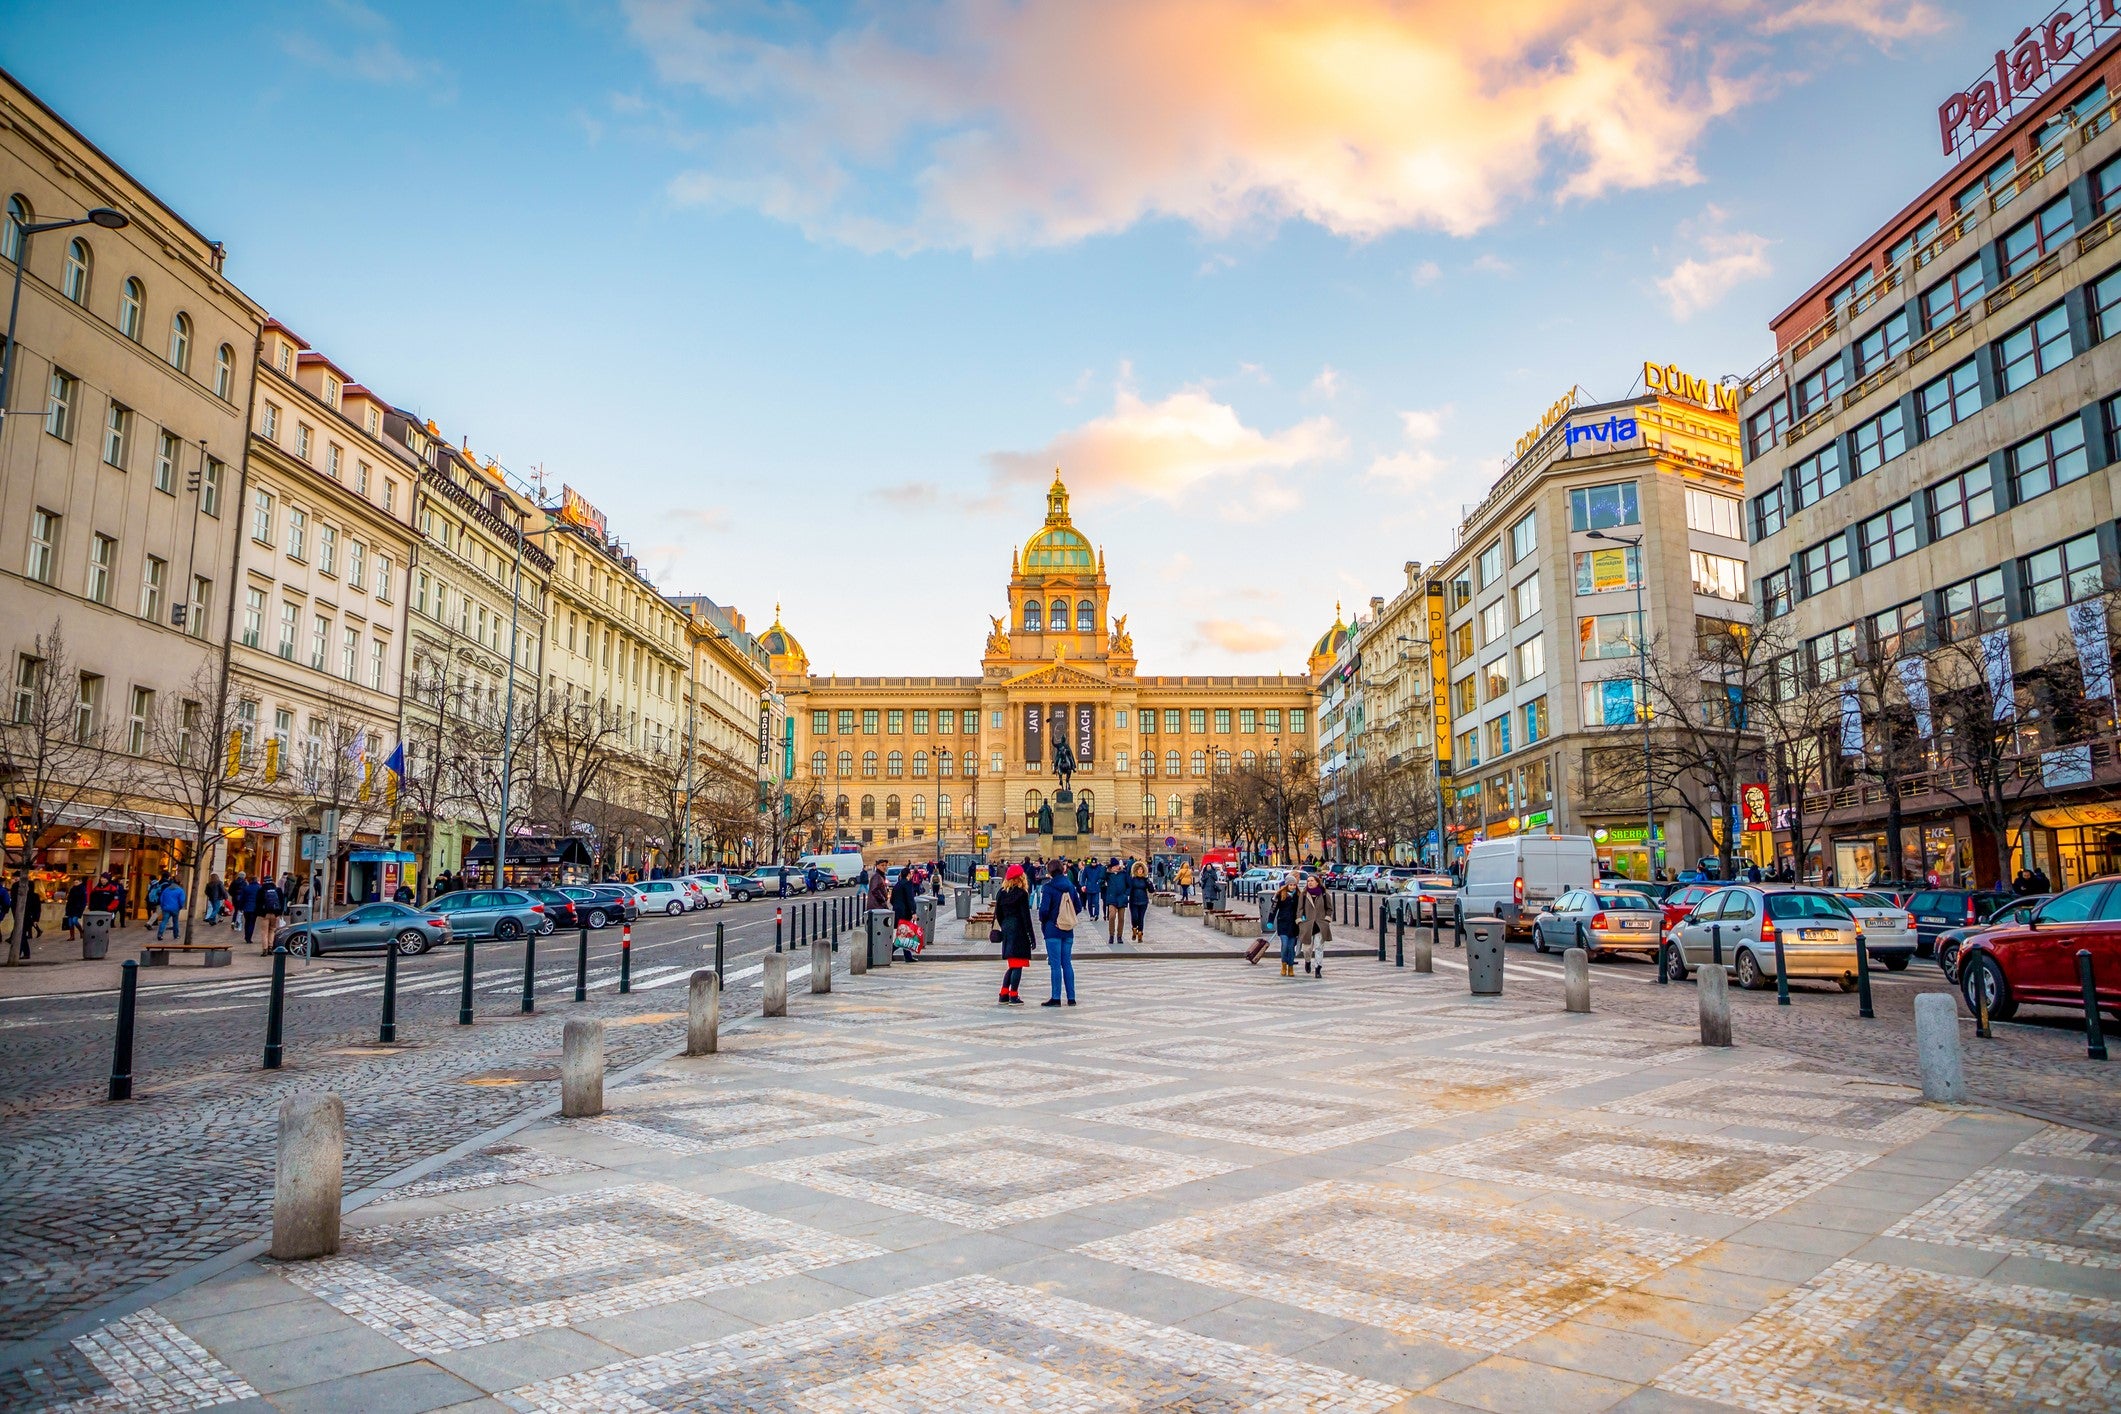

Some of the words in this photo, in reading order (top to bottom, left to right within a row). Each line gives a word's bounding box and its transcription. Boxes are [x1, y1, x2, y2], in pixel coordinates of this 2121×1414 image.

[1938, 12, 2075, 157] Palác
[1644, 361, 1709, 404] DŮM
[1515, 422, 1540, 459] DŮM
[1541, 384, 1578, 428] MÓDY
[1565, 415, 1637, 447] invia
[1431, 611, 1444, 659] DŮM
[1029, 710, 1038, 733] JAN
[1081, 710, 1090, 755] PALACH
[1433, 677, 1448, 744] MÓDY
[1611, 829, 1663, 839] SBERBAK
[1932, 828, 1950, 838] KFC
